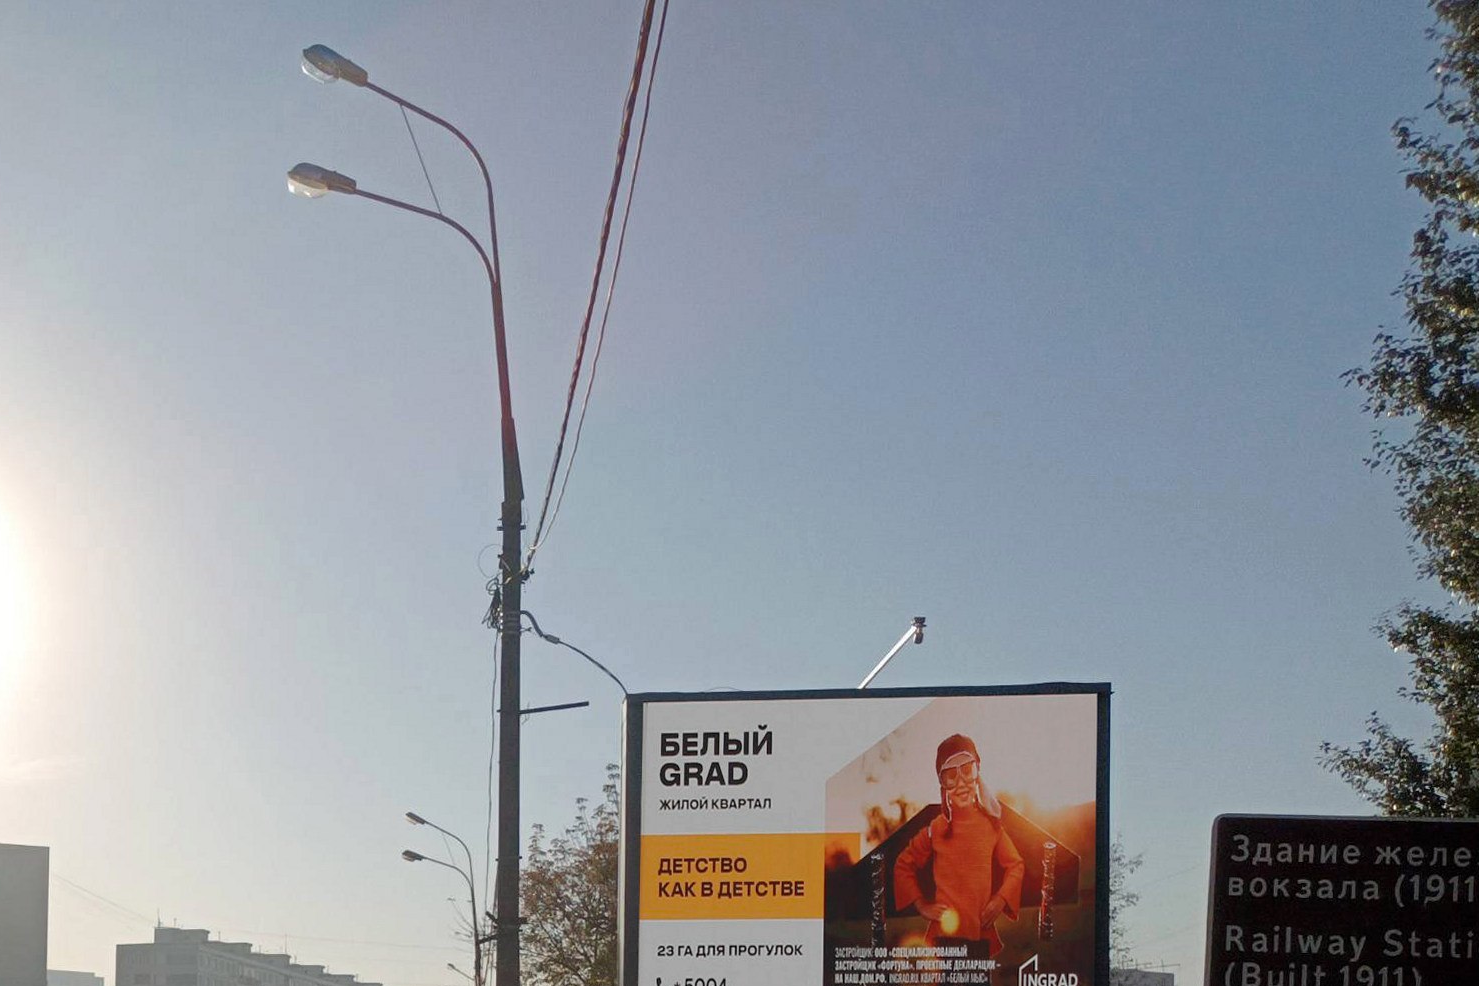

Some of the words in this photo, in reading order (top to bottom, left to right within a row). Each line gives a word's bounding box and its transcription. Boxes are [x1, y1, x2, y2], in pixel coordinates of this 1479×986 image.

[660, 724, 773, 757] БЕЛЫЙ
[659, 762, 749, 787] GRAD
[659, 796, 708, 810] ЖИЛОЙ
[711, 798, 772, 810] КВАРТАЛ
[1230, 834, 1362, 867] Здание
[1374, 845, 1478, 868] желе
[657, 857, 748, 876] ДЕТСТВО
[658, 881, 696, 898] КАК
[700, 881, 714, 897] В
[717, 880, 805, 899] ДЕТСТВЕ
[1227, 876, 1380, 901] вокзала
[657, 945, 675, 957] 23
[677, 945, 694, 957] ГА
[695, 945, 725, 958] ДЛЯ
[728, 944, 803, 957] ПРОГУЛОК
[1224, 924, 1367, 963] Railway
[1382, 928, 1478, 960] Stati
